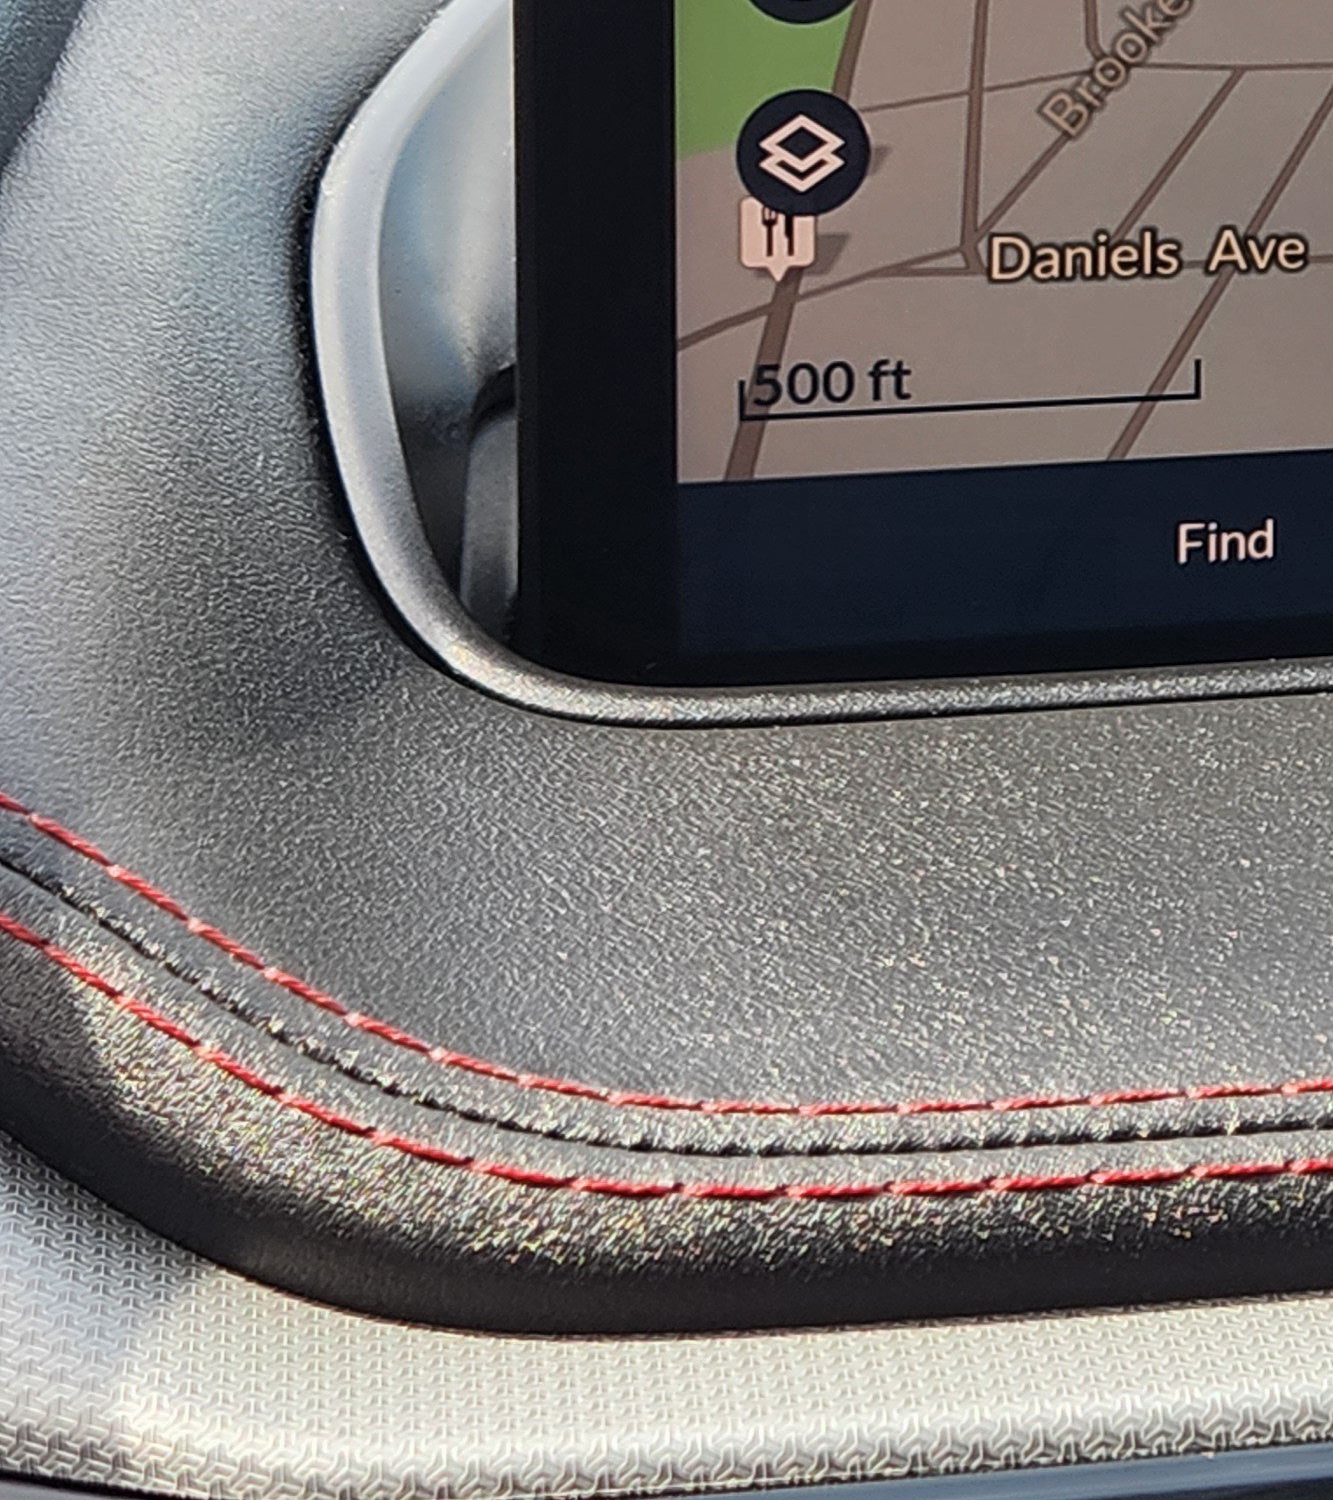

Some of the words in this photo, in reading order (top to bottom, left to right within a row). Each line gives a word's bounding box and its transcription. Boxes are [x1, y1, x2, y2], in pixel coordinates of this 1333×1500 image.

[988, 230, 1182, 282] Daniels
[1208, 227, 1307, 272] Ave
[751, 361, 857, 407] 500
[867, 358, 912, 402] ft
[1176, 518, 1276, 565] Find
